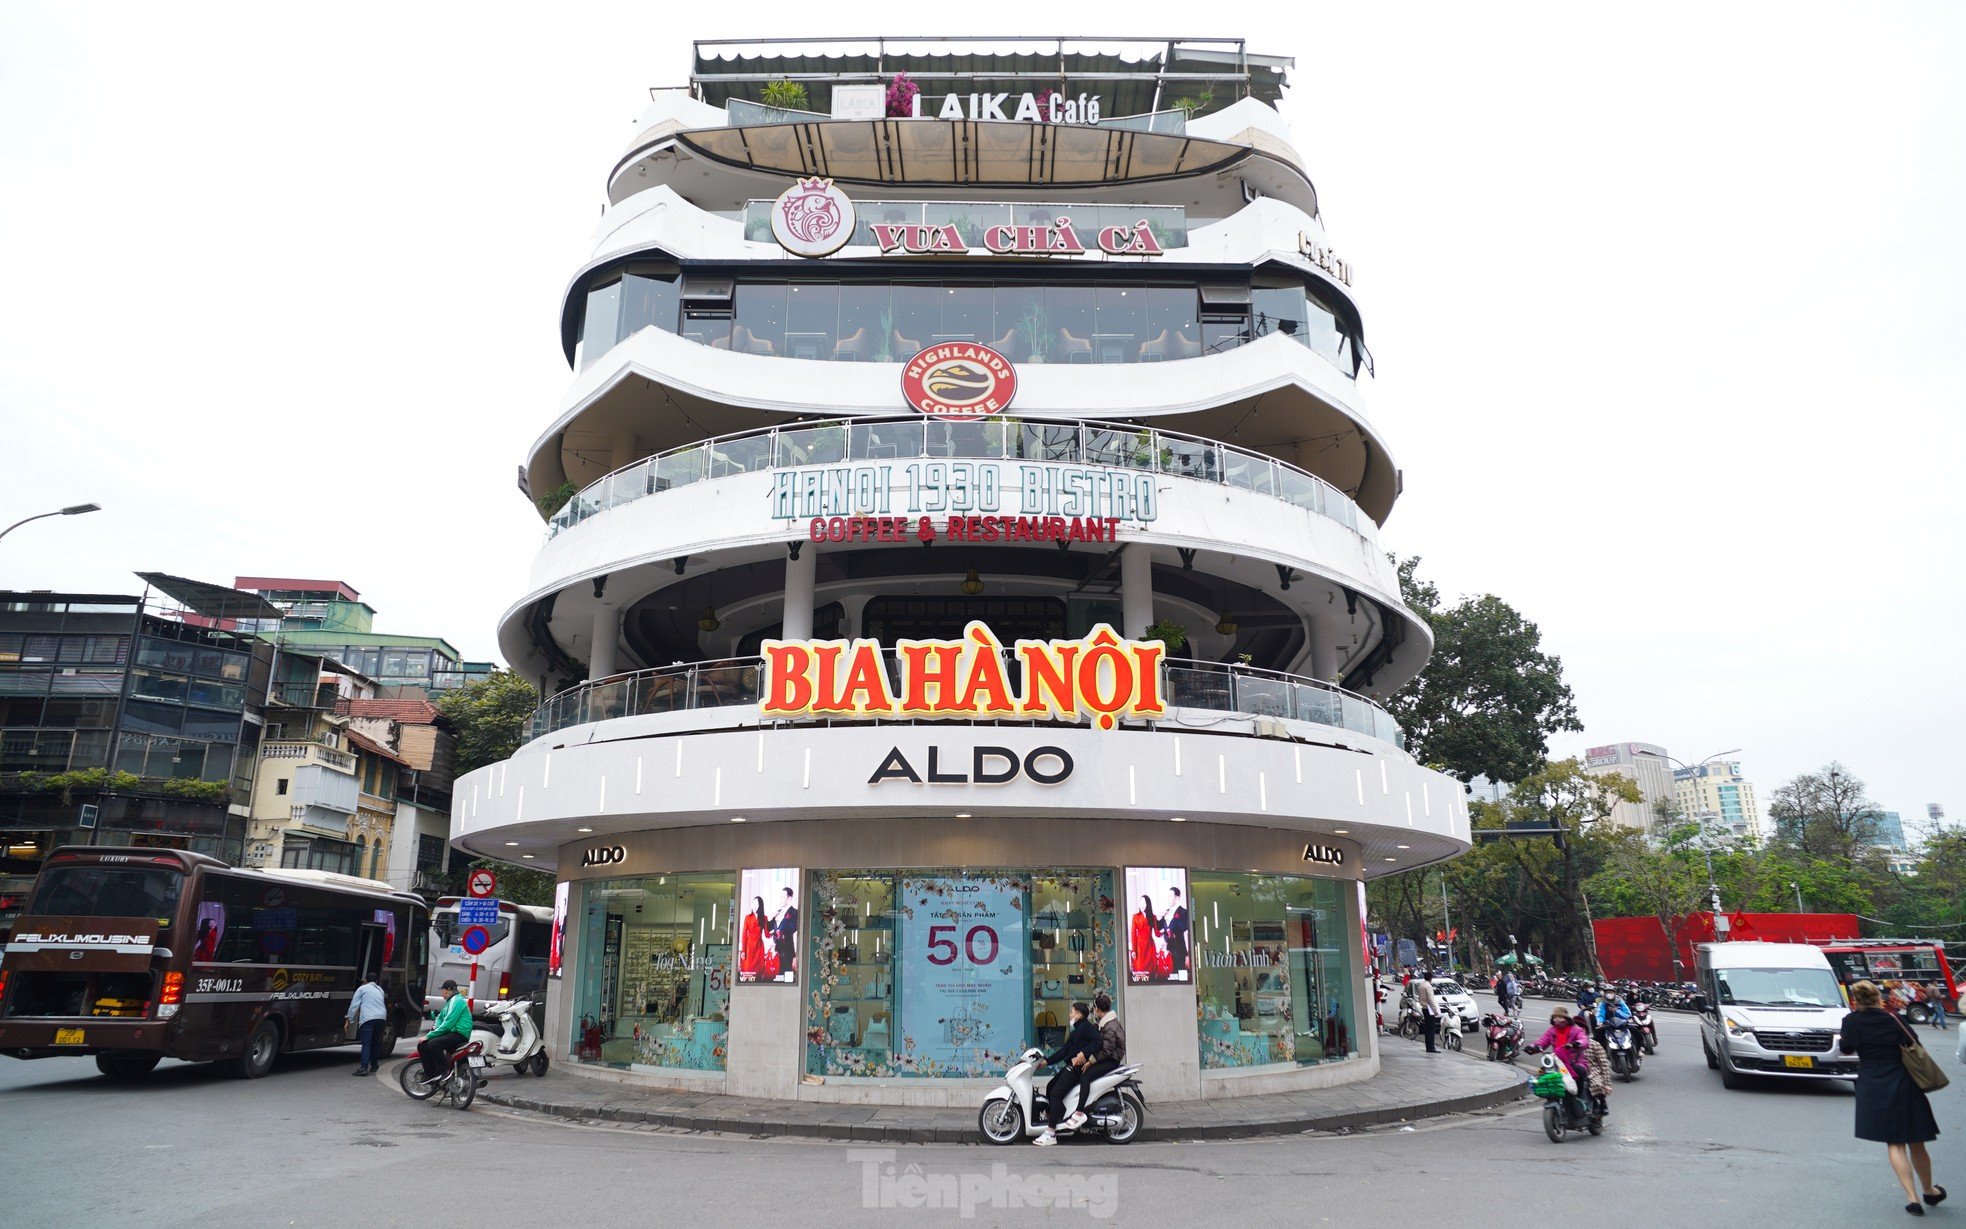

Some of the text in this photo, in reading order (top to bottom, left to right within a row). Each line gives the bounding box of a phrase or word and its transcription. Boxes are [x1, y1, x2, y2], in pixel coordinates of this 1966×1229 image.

[912, 92, 1100, 124] LAIKA Café
[870, 216, 1164, 255] VUA CHẢ CÁ
[908, 346, 1010, 379] HIGHLANDS
[921, 398, 999, 414] COFFEE
[771, 463, 1157, 521] HANOI 1930 BISTRO
[810, 516, 1120, 543] COFFEE & RESTAURANT
[763, 625, 1164, 731] BIA HÀ NỘI
[867, 745, 1074, 784] ALDO
[100, 855, 130, 863] LUXURY
[581, 845, 626, 867] ALDO
[1302, 844, 1344, 866] ALDO
[15, 934, 150, 944] FELIXLIMOUSINE
[926, 925, 999, 966] 50
[196, 979, 243, 992] 35F-001.12
